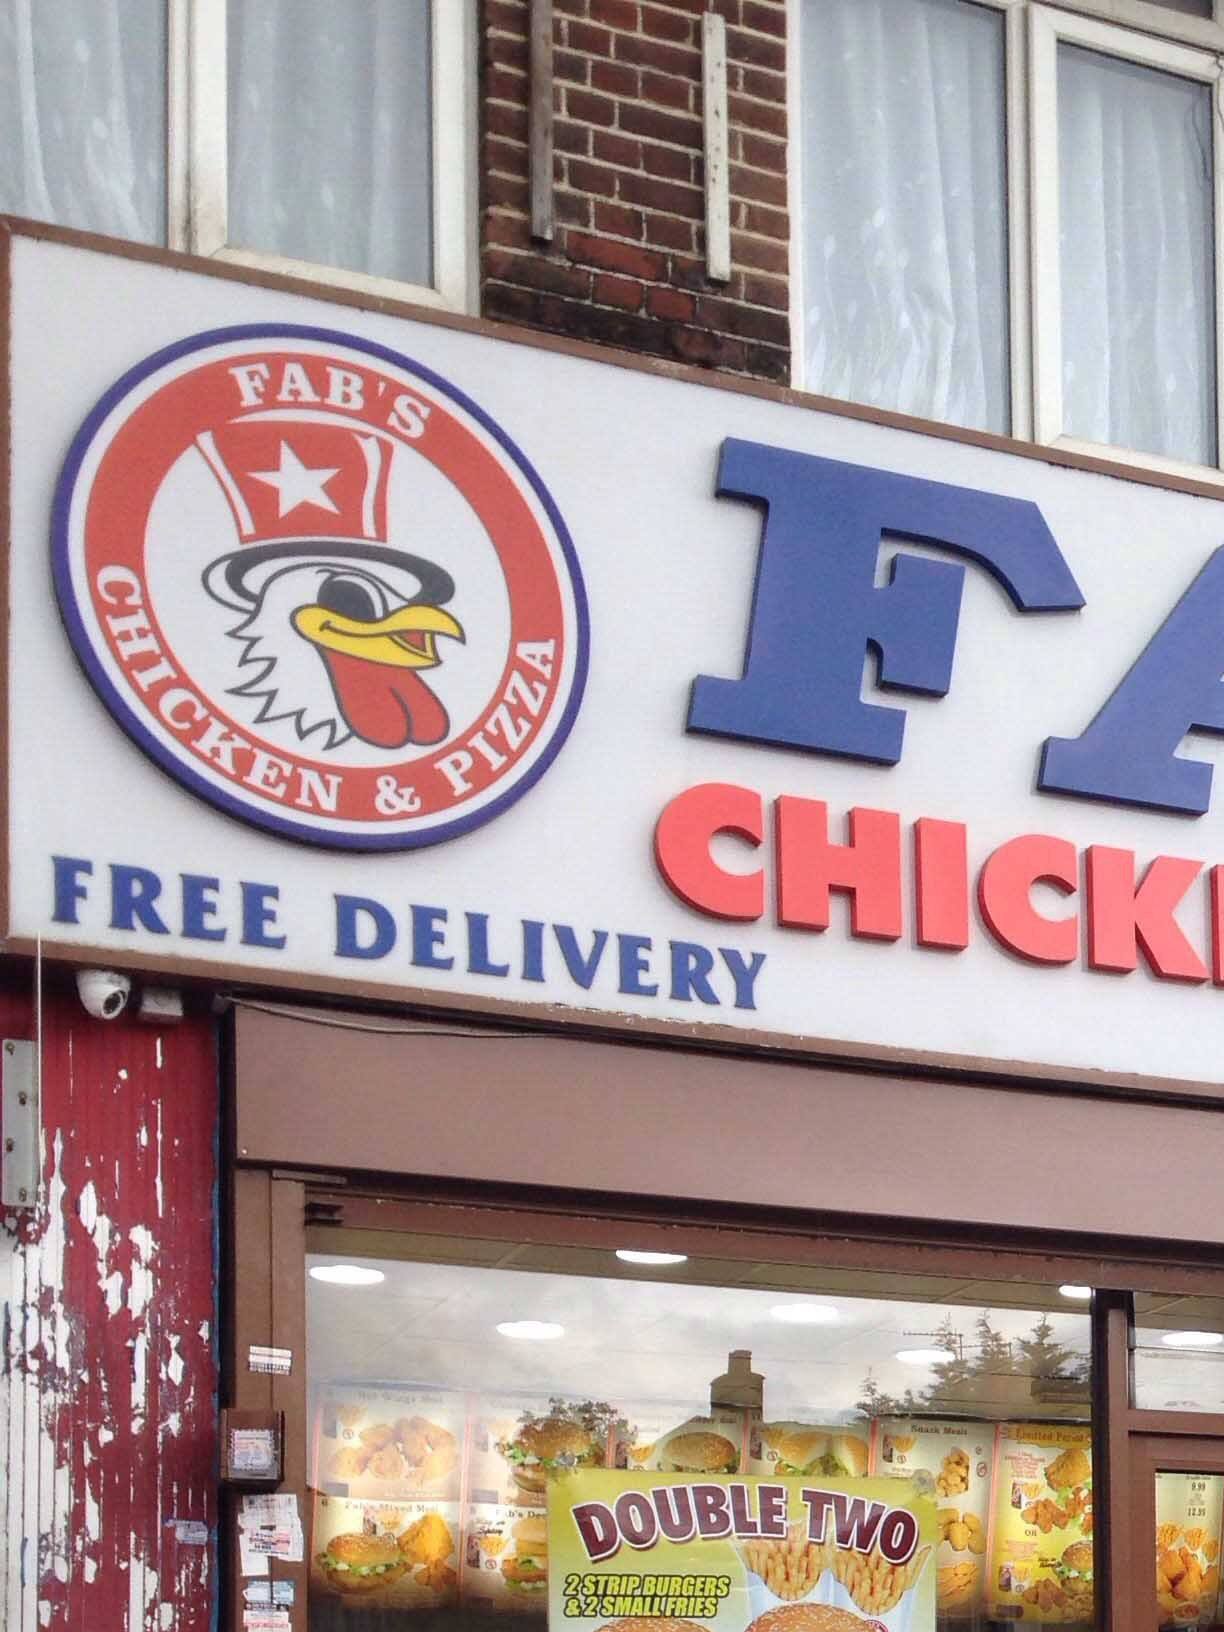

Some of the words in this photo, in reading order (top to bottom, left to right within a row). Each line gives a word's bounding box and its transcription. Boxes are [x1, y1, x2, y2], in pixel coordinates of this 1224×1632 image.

[230, 363, 431, 441] FAB'S
[95, 564, 343, 811] CHICKEN
[374, 775, 421, 815] &
[433, 637, 556, 796] PIZZA
[52, 856, 288, 949] FREE
[334, 894, 767, 1011] DELIVERY
[572, 1484, 788, 1563] DOUBLE
[802, 1488, 919, 1566] TWO
[565, 1574, 581, 1596] 2
[581, 1574, 640, 1598] STRIP
[640, 1576, 731, 1597] BURGERS
[565, 1598, 582, 1618] &
[583, 1598, 599, 1618] 2
[600, 1598, 663, 1618] SMALL
[663, 1598, 719, 1618] FRIES
